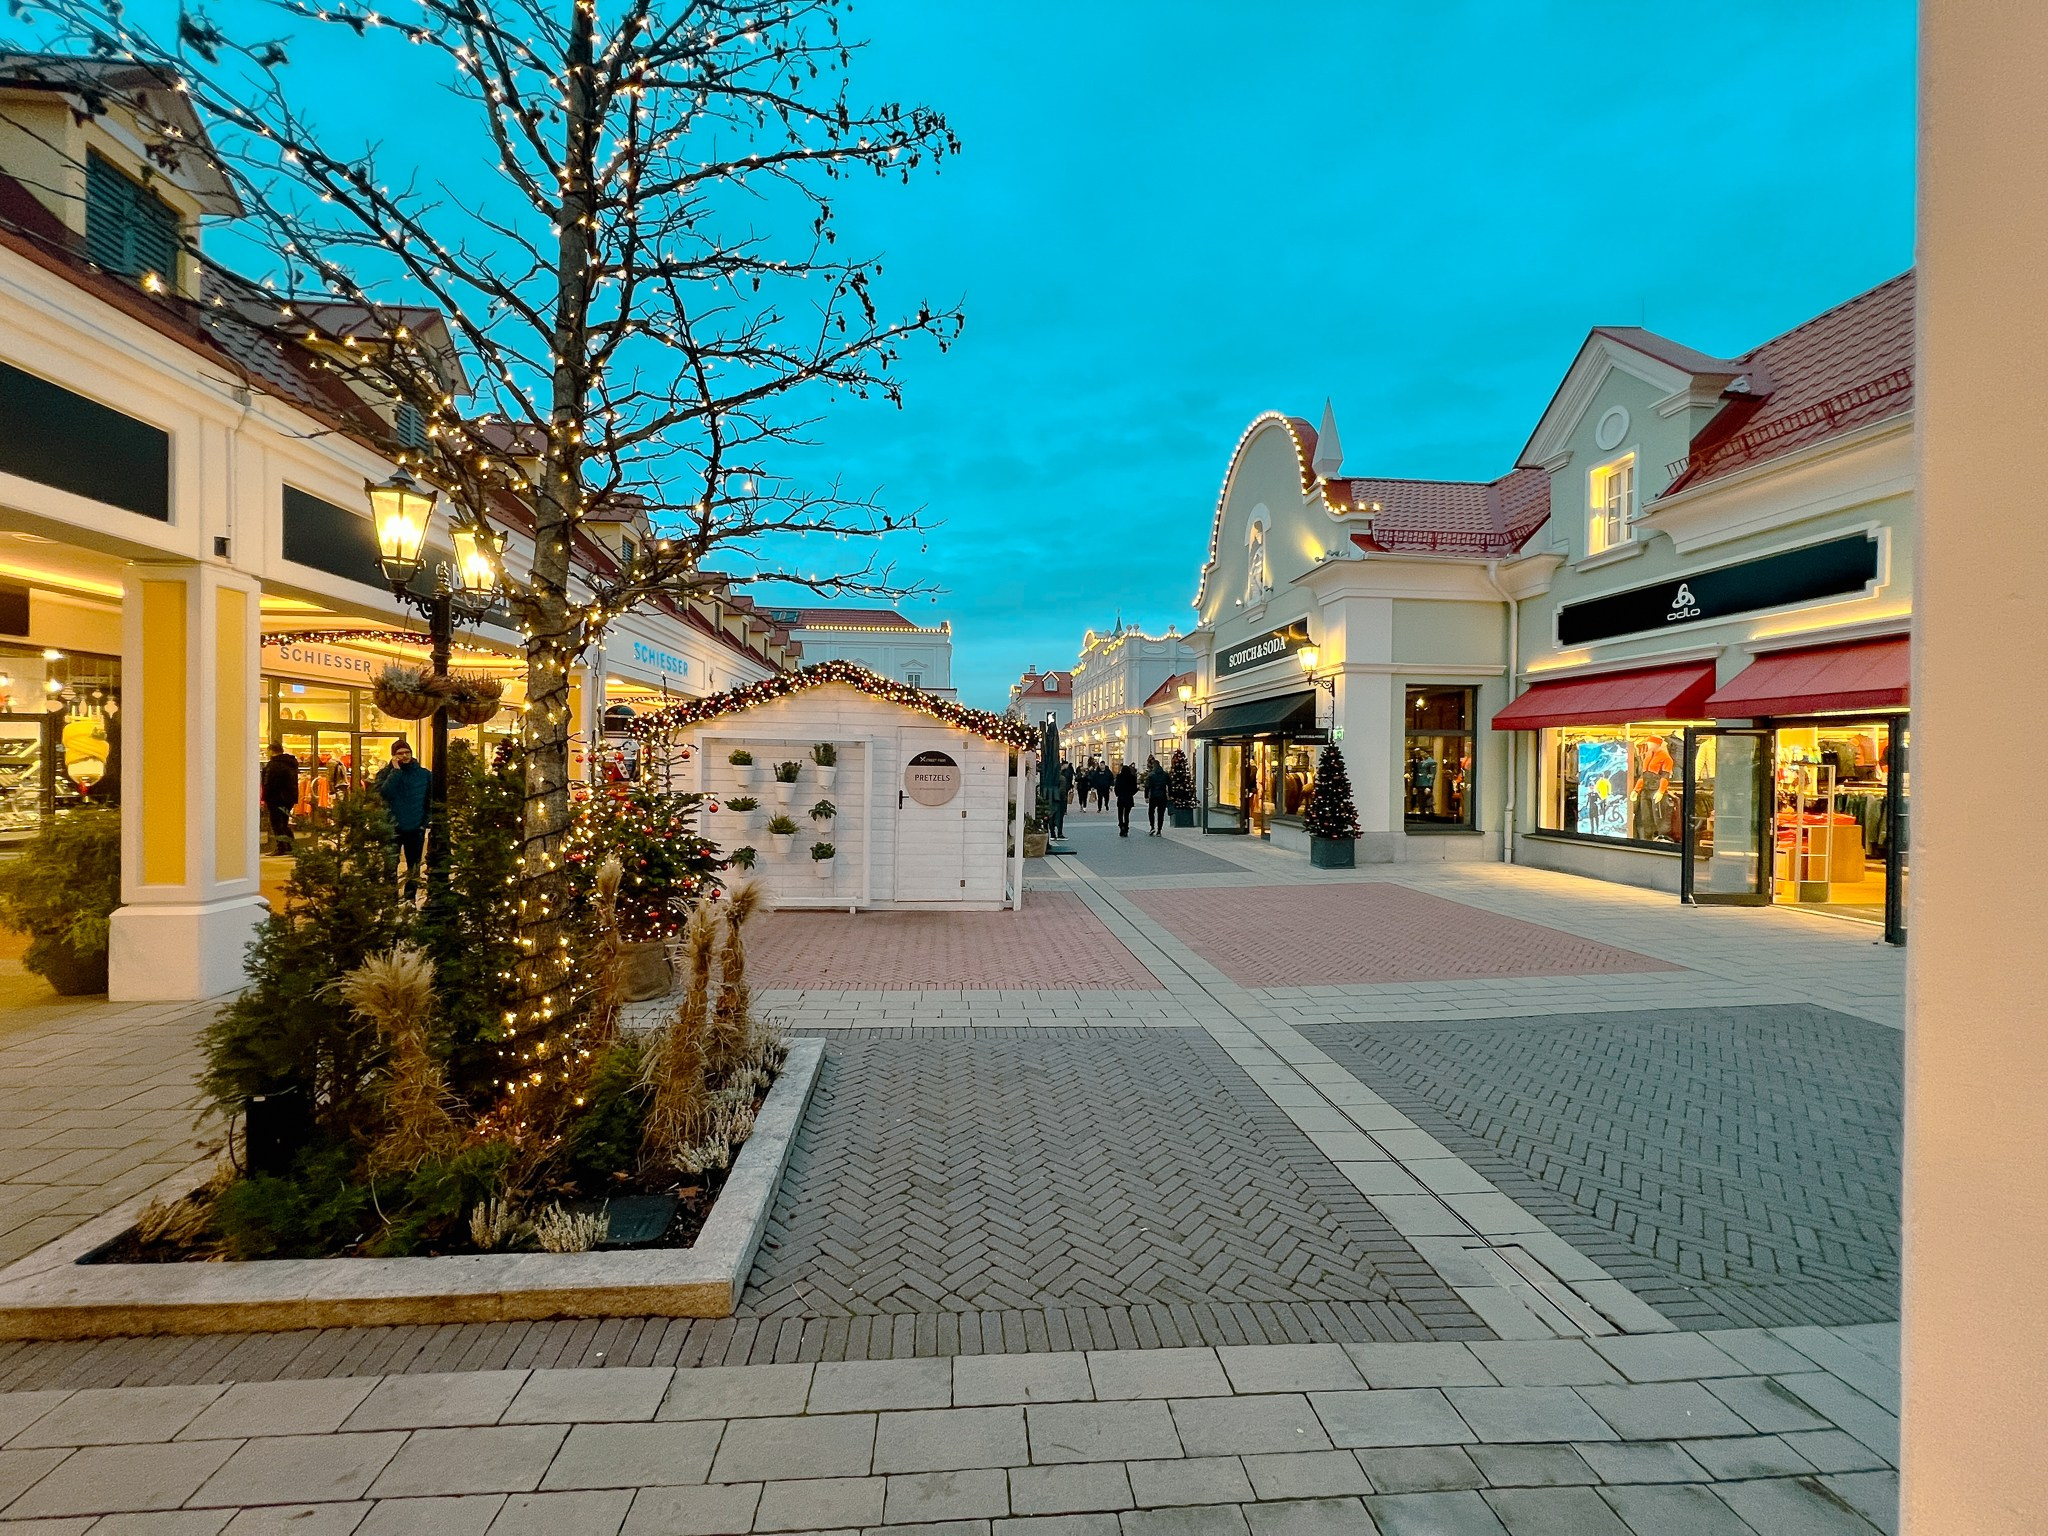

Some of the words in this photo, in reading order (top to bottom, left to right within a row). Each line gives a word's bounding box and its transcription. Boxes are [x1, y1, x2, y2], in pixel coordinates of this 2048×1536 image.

[1667, 607, 1700, 620] odlo
[280, 646, 371, 672] SCHIESSER
[634, 642, 688, 676] SCHIESSER
[1229, 636, 1286, 667] SCOTCH&SODA
